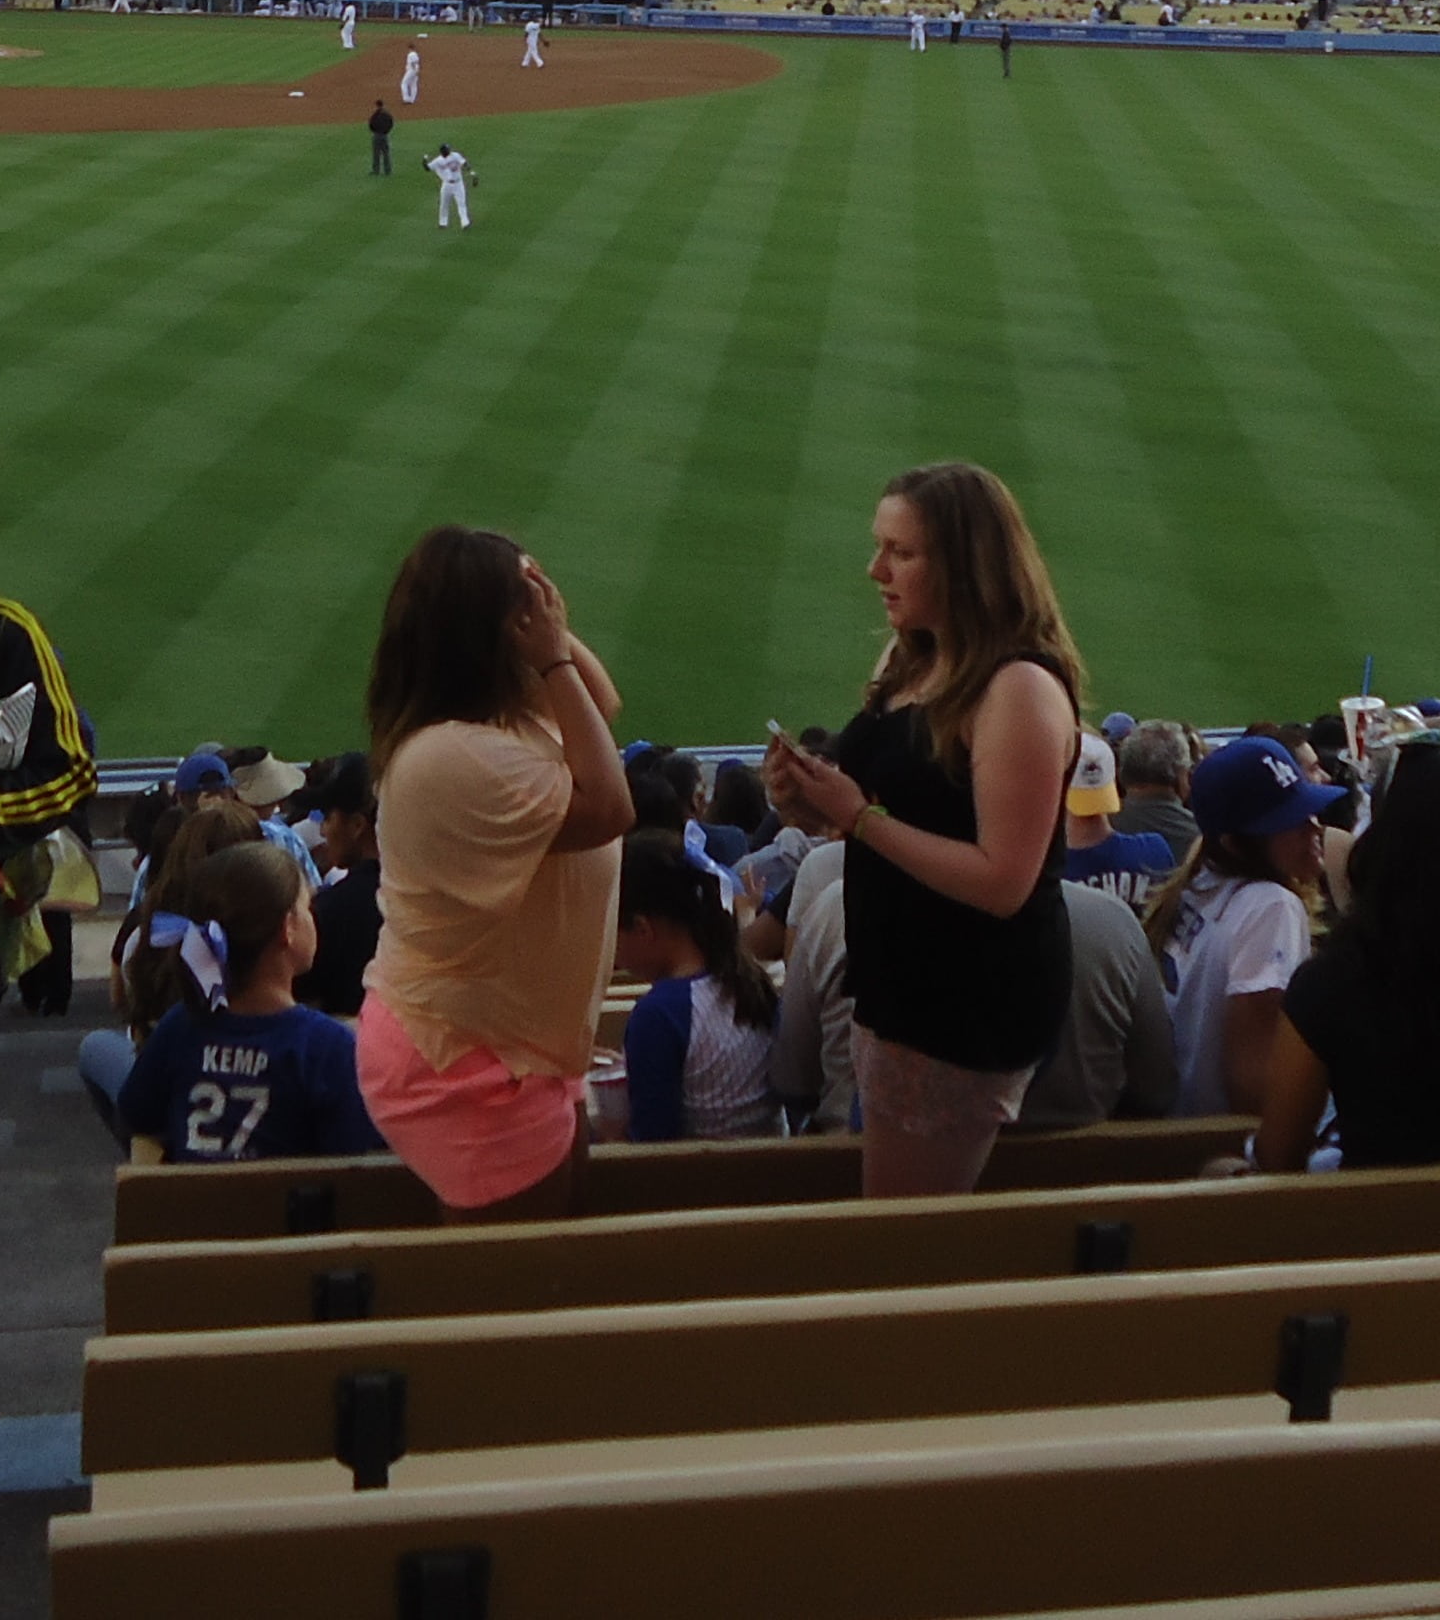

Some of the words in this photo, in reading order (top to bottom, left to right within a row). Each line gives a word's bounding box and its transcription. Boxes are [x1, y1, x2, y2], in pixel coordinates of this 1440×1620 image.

[1262, 756, 1299, 788] LA
[202, 1044, 269, 1077] KEMP
[186, 1081, 270, 1156] 27
